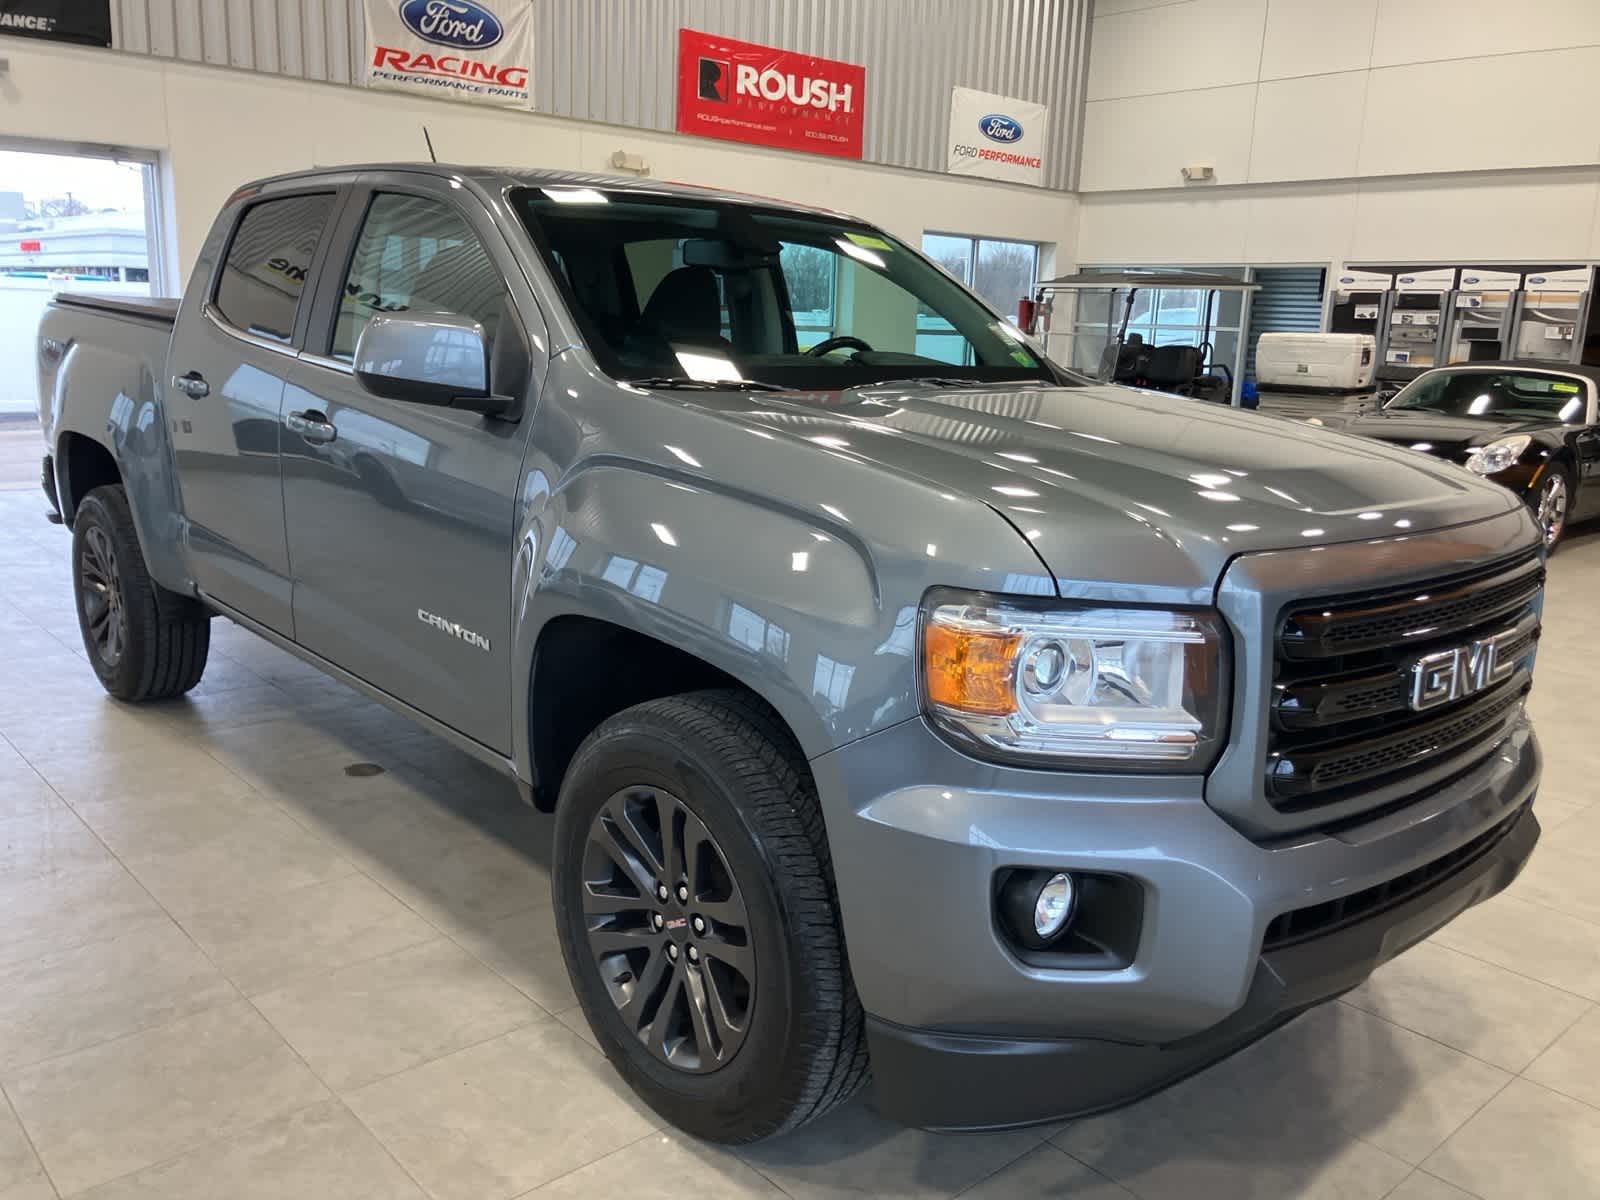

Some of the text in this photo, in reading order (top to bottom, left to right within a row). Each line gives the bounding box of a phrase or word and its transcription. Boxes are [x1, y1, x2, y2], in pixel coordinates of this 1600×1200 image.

[0, 12, 52, 32] ANCE.
[419, 1, 484, 43] Ford
[372, 46, 529, 89] RACING
[372, 71, 529, 99] PERFORMANCE PARTS
[736, 63, 853, 113] ROUSH
[987, 118, 1016, 140] Ford
[953, 144, 1042, 169] FORD PERFORMANCE
[417, 608, 490, 652] CANYON
[1409, 627, 1519, 712] GMC
